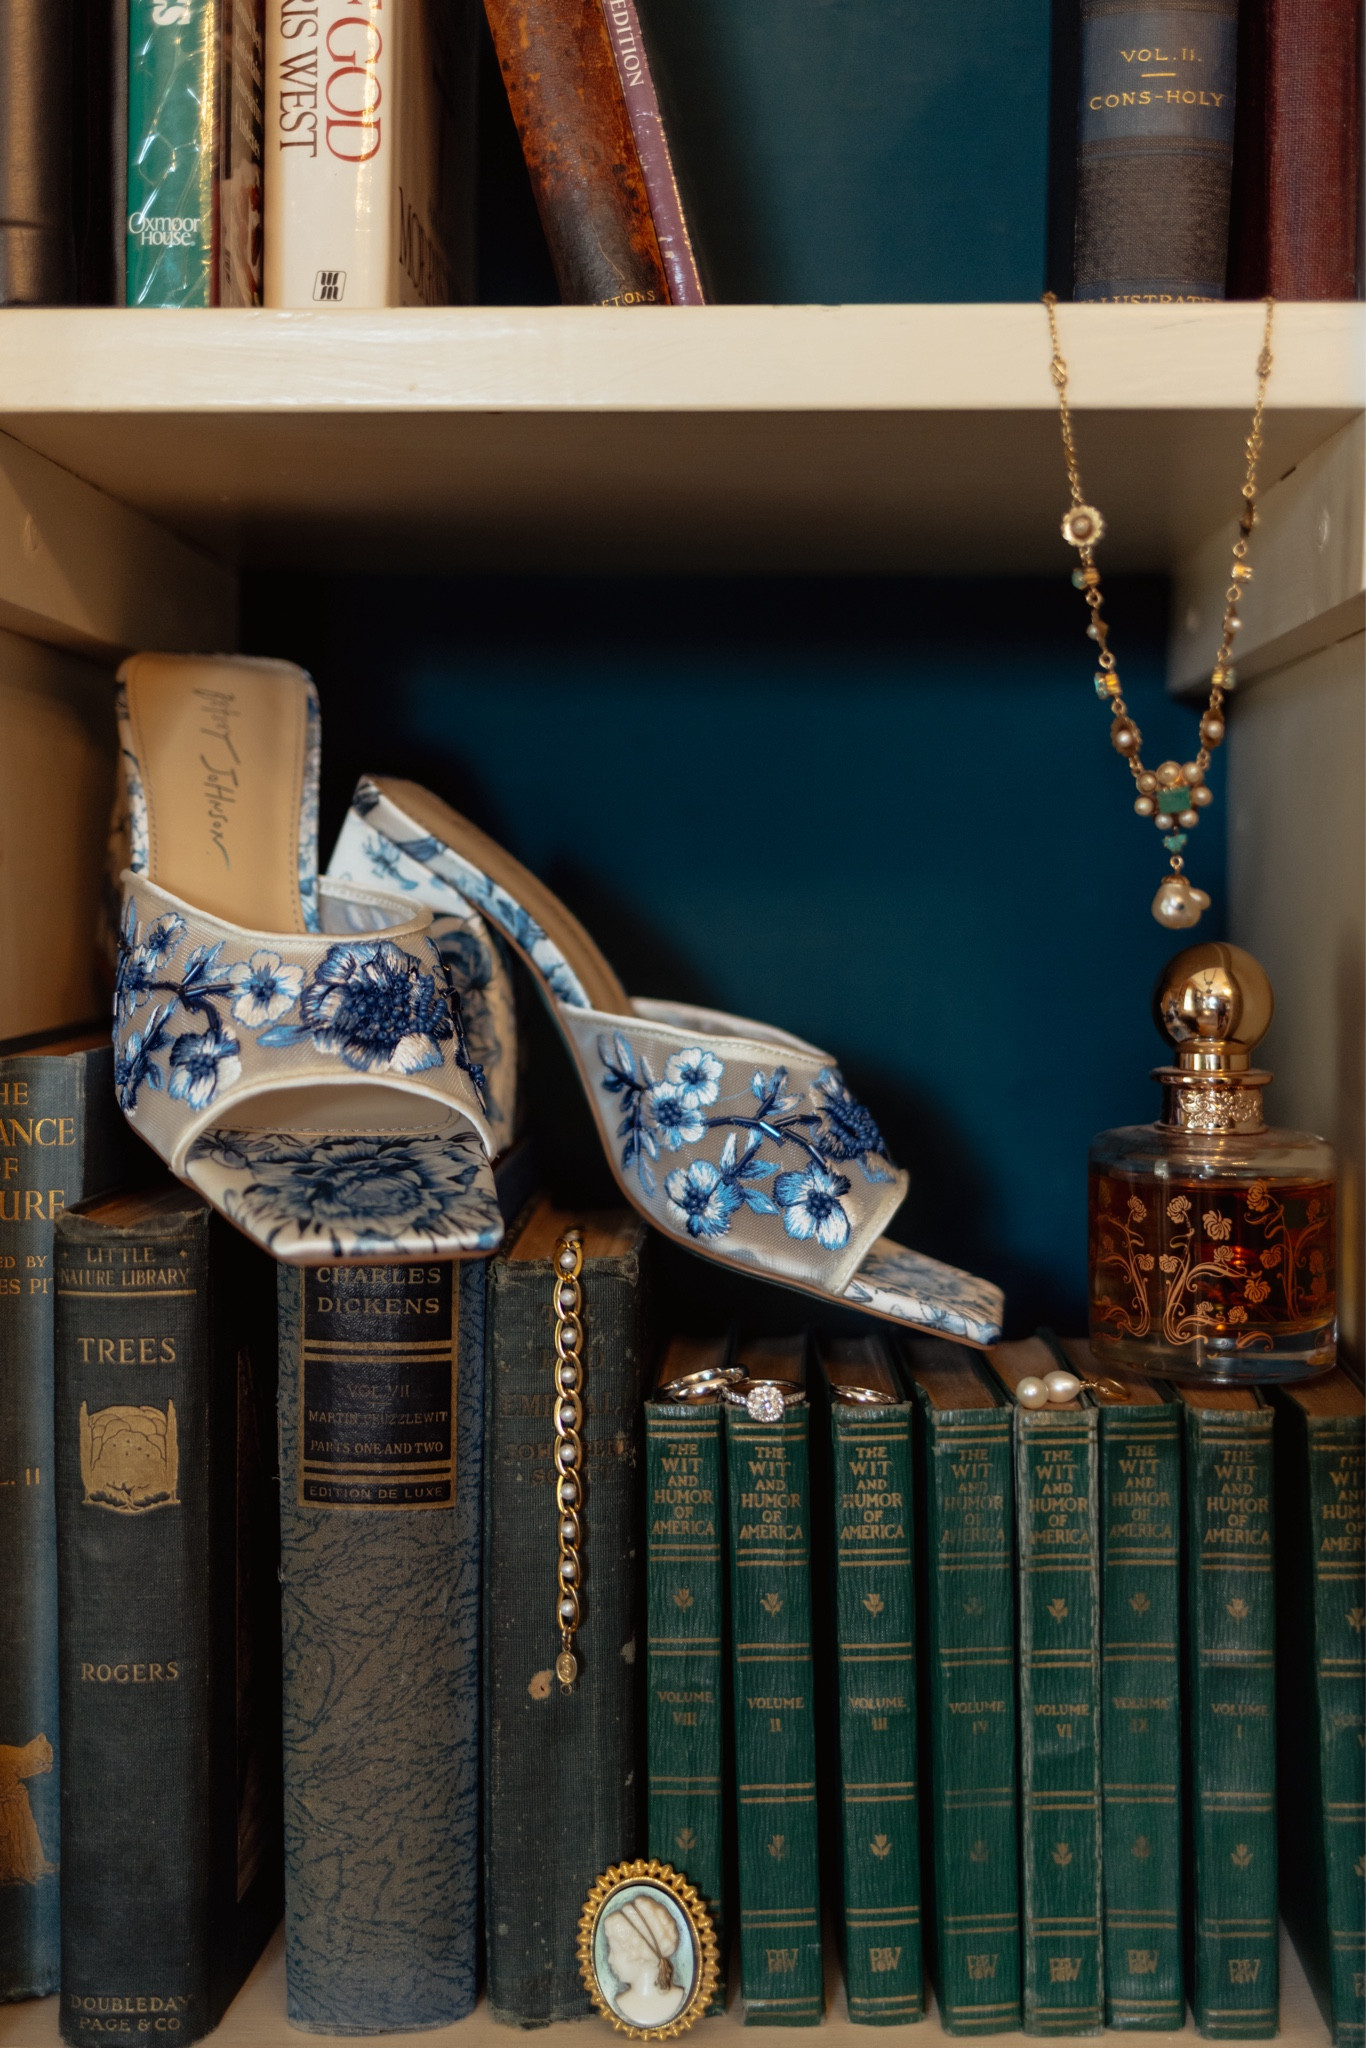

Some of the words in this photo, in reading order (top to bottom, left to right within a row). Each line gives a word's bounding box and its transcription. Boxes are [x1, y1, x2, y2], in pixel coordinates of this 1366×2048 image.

[610, 0, 645, 86] EDITION
[1120, 48, 1177, 63] VOL.
[325, 17, 382, 162] GOD
[279, 47, 318, 157] WEST
[1090, 90, 1227, 110] CONS-HOLY
[129, 212, 201, 234] Oxmoor
[26, 1255, 48, 1268] BY
[87, 1247, 156, 1263] LITTLE
[60, 1268, 115, 1286] NATURE
[122, 1267, 190, 1286] LIBRARY
[317, 1267, 441, 1284] CHARLES
[30, 1277, 54, 1295] PI
[317, 1297, 440, 1315] DICKENS
[78, 1337, 176, 1364] TREES
[308, 1410, 358, 1424] MARTIN
[355, 1442, 380, 1455] ONE
[384, 1442, 412, 1454] AND
[415, 1441, 443, 1453] TWO
[668, 1444, 698, 1455] THE
[755, 1446, 786, 1459] THE
[855, 1447, 888, 1458] THE
[959, 1449, 988, 1460] THE
[1125, 1445, 1156, 1457] THE
[1042, 1450, 1073, 1462] THE
[1221, 1450, 1254, 1462] THE
[661, 1458, 703, 1472] WIT
[748, 1461, 791, 1477] WIT
[849, 1461, 893, 1476] WIT
[952, 1463, 993, 1478] WIT
[1118, 1459, 1160, 1474] WIT
[1214, 1464, 1258, 1480] WIT
[1035, 1465, 1078, 1480] WIT
[667, 1476, 698, 1487] AND
[755, 1480, 785, 1491] AND
[856, 1479, 887, 1490] AND
[1125, 1477, 1156, 1488] AND
[309, 1486, 370, 1498] EDITION
[378, 1487, 397, 1498] DE
[405, 1487, 443, 1498] LUXE
[1042, 1483, 1073, 1495] AND
[1221, 1483, 1253, 1495] AND
[654, 1490, 714, 1504] HUMOR
[741, 1493, 801, 1508] HUMOR
[842, 1493, 903, 1508] HUMOR
[1112, 1491, 1170, 1507] HUMOR
[1206, 1496, 1269, 1512] HUMOR
[1029, 1497, 1088, 1512] HUMOR
[1323, 1504, 1364, 1519] HUM
[674, 1506, 693, 1518] OF
[762, 1510, 781, 1522] OF
[864, 1510, 884, 1522] OF
[1131, 1508, 1150, 1520] OF
[652, 1520, 715, 1535] AMERICA
[1048, 1514, 1068, 1527] OF
[1227, 1514, 1248, 1527] OF
[739, 1525, 803, 1539] AMERICA
[840, 1524, 904, 1539] AMERICA
[1029, 1529, 1090, 1544] AMERICA
[1110, 1523, 1172, 1538] AMERICA
[1204, 1528, 1270, 1544] AMERICA
[81, 1661, 179, 1683] ROGERS
[657, 1691, 713, 1703] VOLUME
[747, 1697, 804, 1709] VOLUME
[849, 1697, 906, 1709] VOLUME
[1112, 1697, 1169, 1709] VOLUME
[949, 1701, 1006, 1714] VOLUME
[1034, 1704, 1090, 1716] VOLUME
[1211, 1703, 1269, 1716] VOLUME
[70, 1993, 193, 2013] DOUBLEDAY
[80, 2017, 131, 2031] PAGE
[138, 2016, 150, 2031] &
